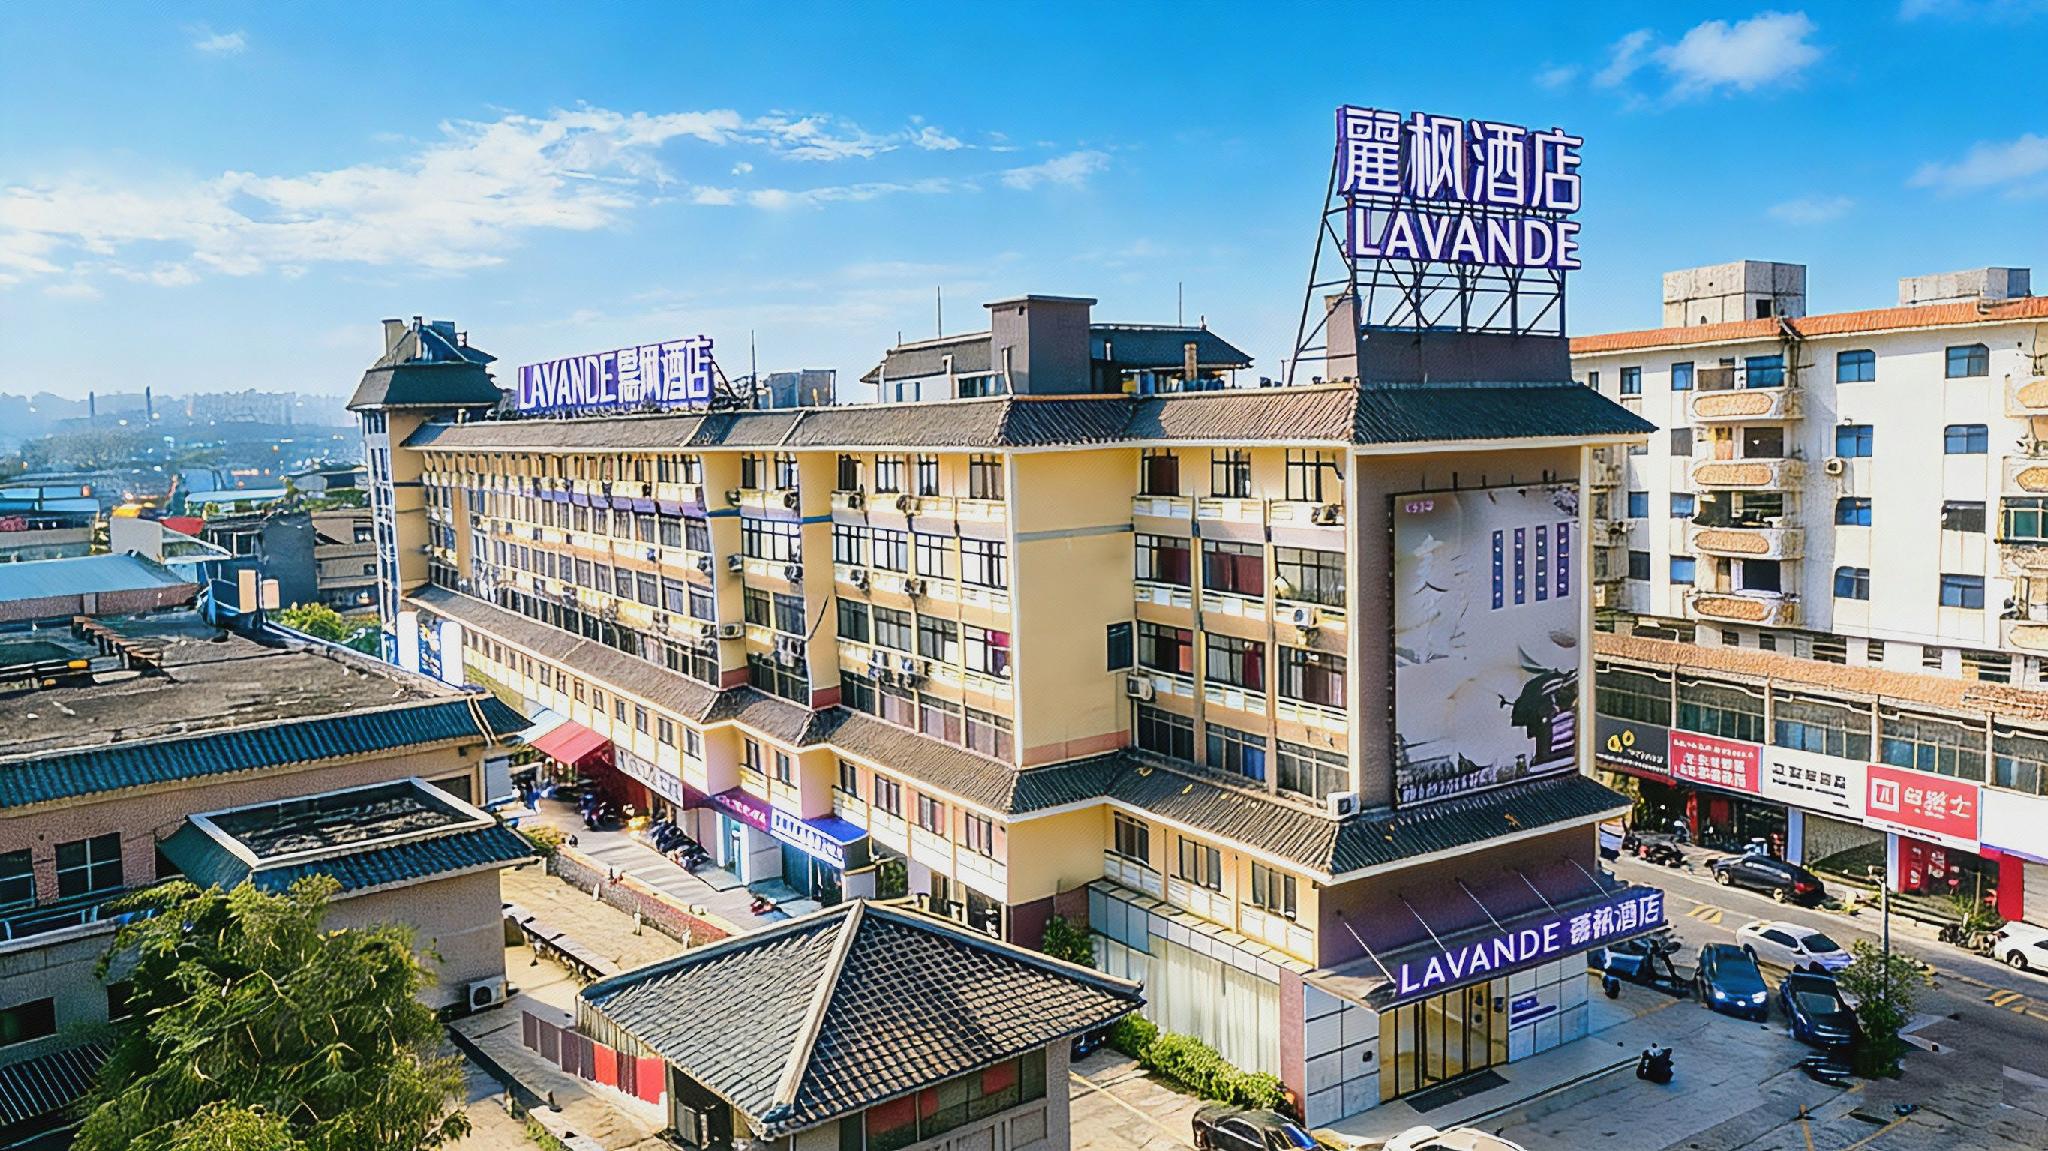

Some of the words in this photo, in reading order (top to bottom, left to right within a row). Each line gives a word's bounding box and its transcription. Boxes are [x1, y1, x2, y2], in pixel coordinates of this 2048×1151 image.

[1354, 207, 1582, 269] LAVANDE
[518, 352, 617, 410] LAVANDE
[1400, 921, 1561, 996] LAVANDE
